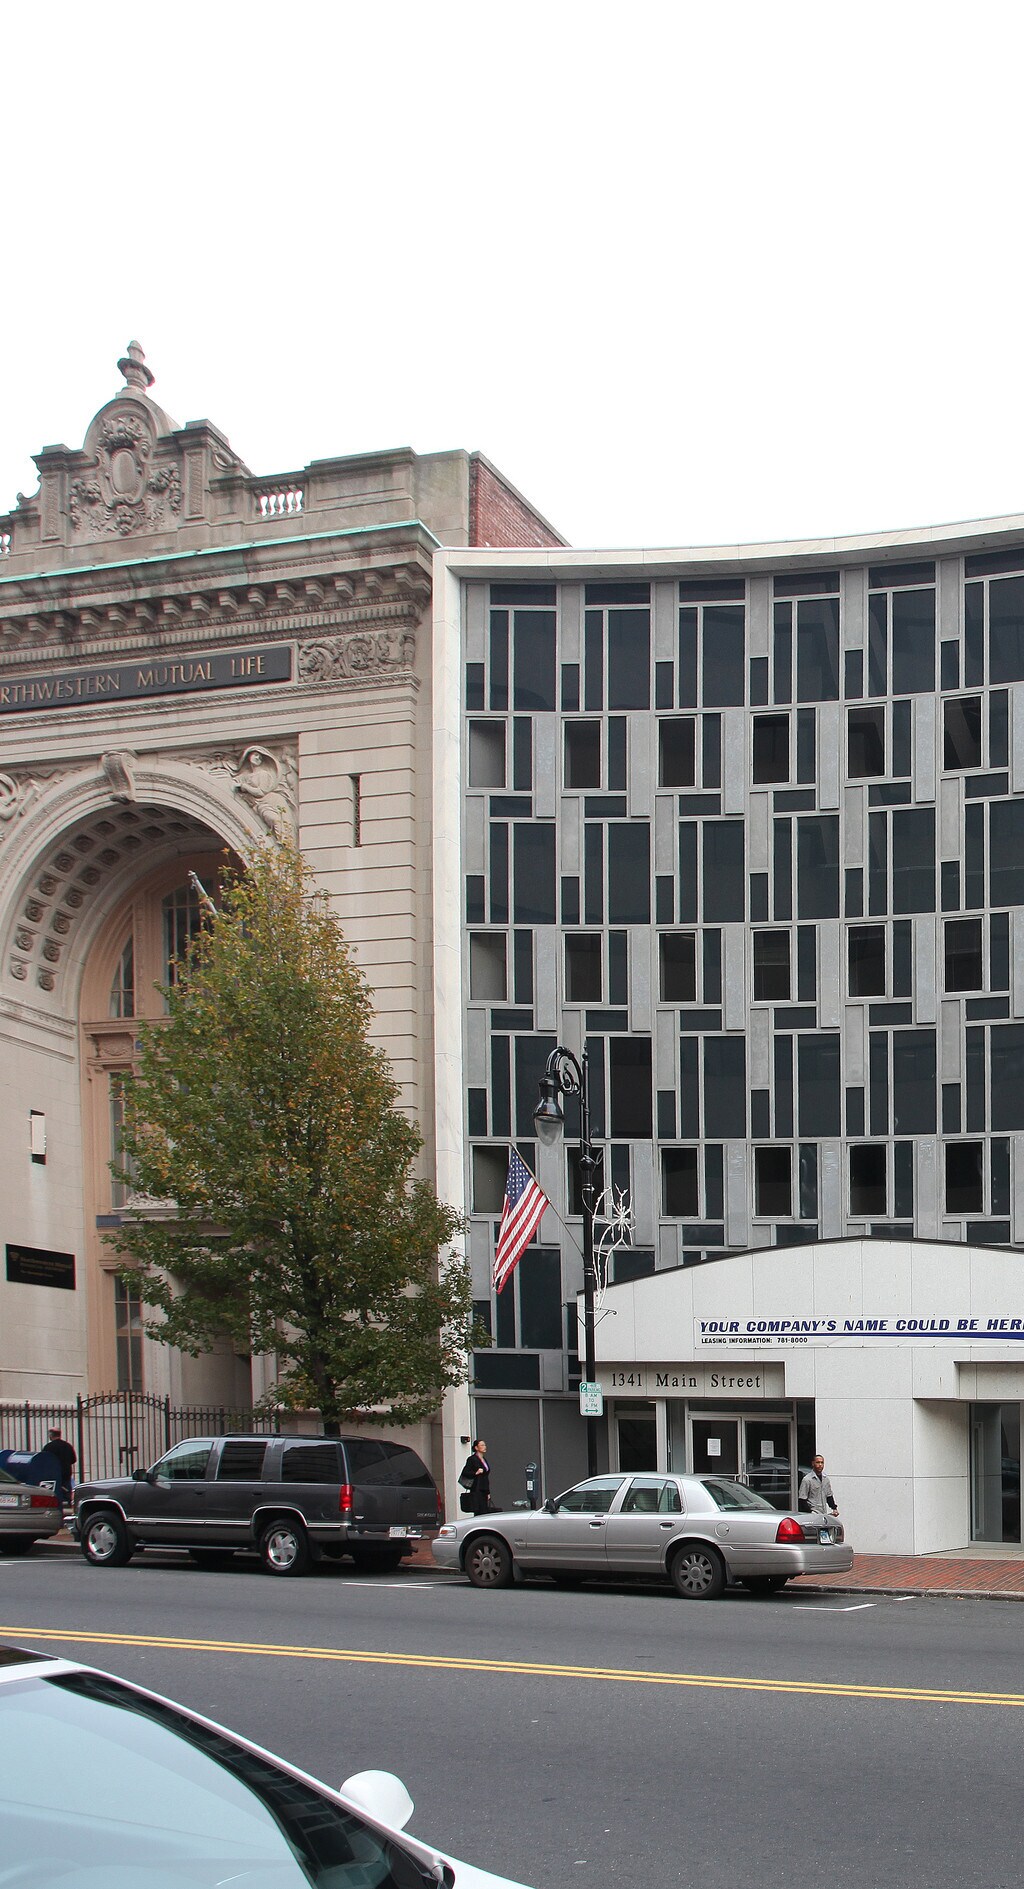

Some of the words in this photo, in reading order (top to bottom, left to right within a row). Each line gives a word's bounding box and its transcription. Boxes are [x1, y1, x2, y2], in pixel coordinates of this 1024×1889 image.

[137, 662, 216, 689] MUTUAL
[231, 655, 267, 678] LIFE
[700, 1321, 740, 1333] YOUR
[746, 1320, 837, 1333] COMPANY'S
[843, 1319, 889, 1332] NAME
[895, 1319, 950, 1331] COULD
[956, 1319, 980, 1331] BE
[611, 1373, 643, 1387] 1341
[656, 1373, 698, 1388] Main
[710, 1373, 761, 1388] Street
[582, 1384, 587, 1392] 2
